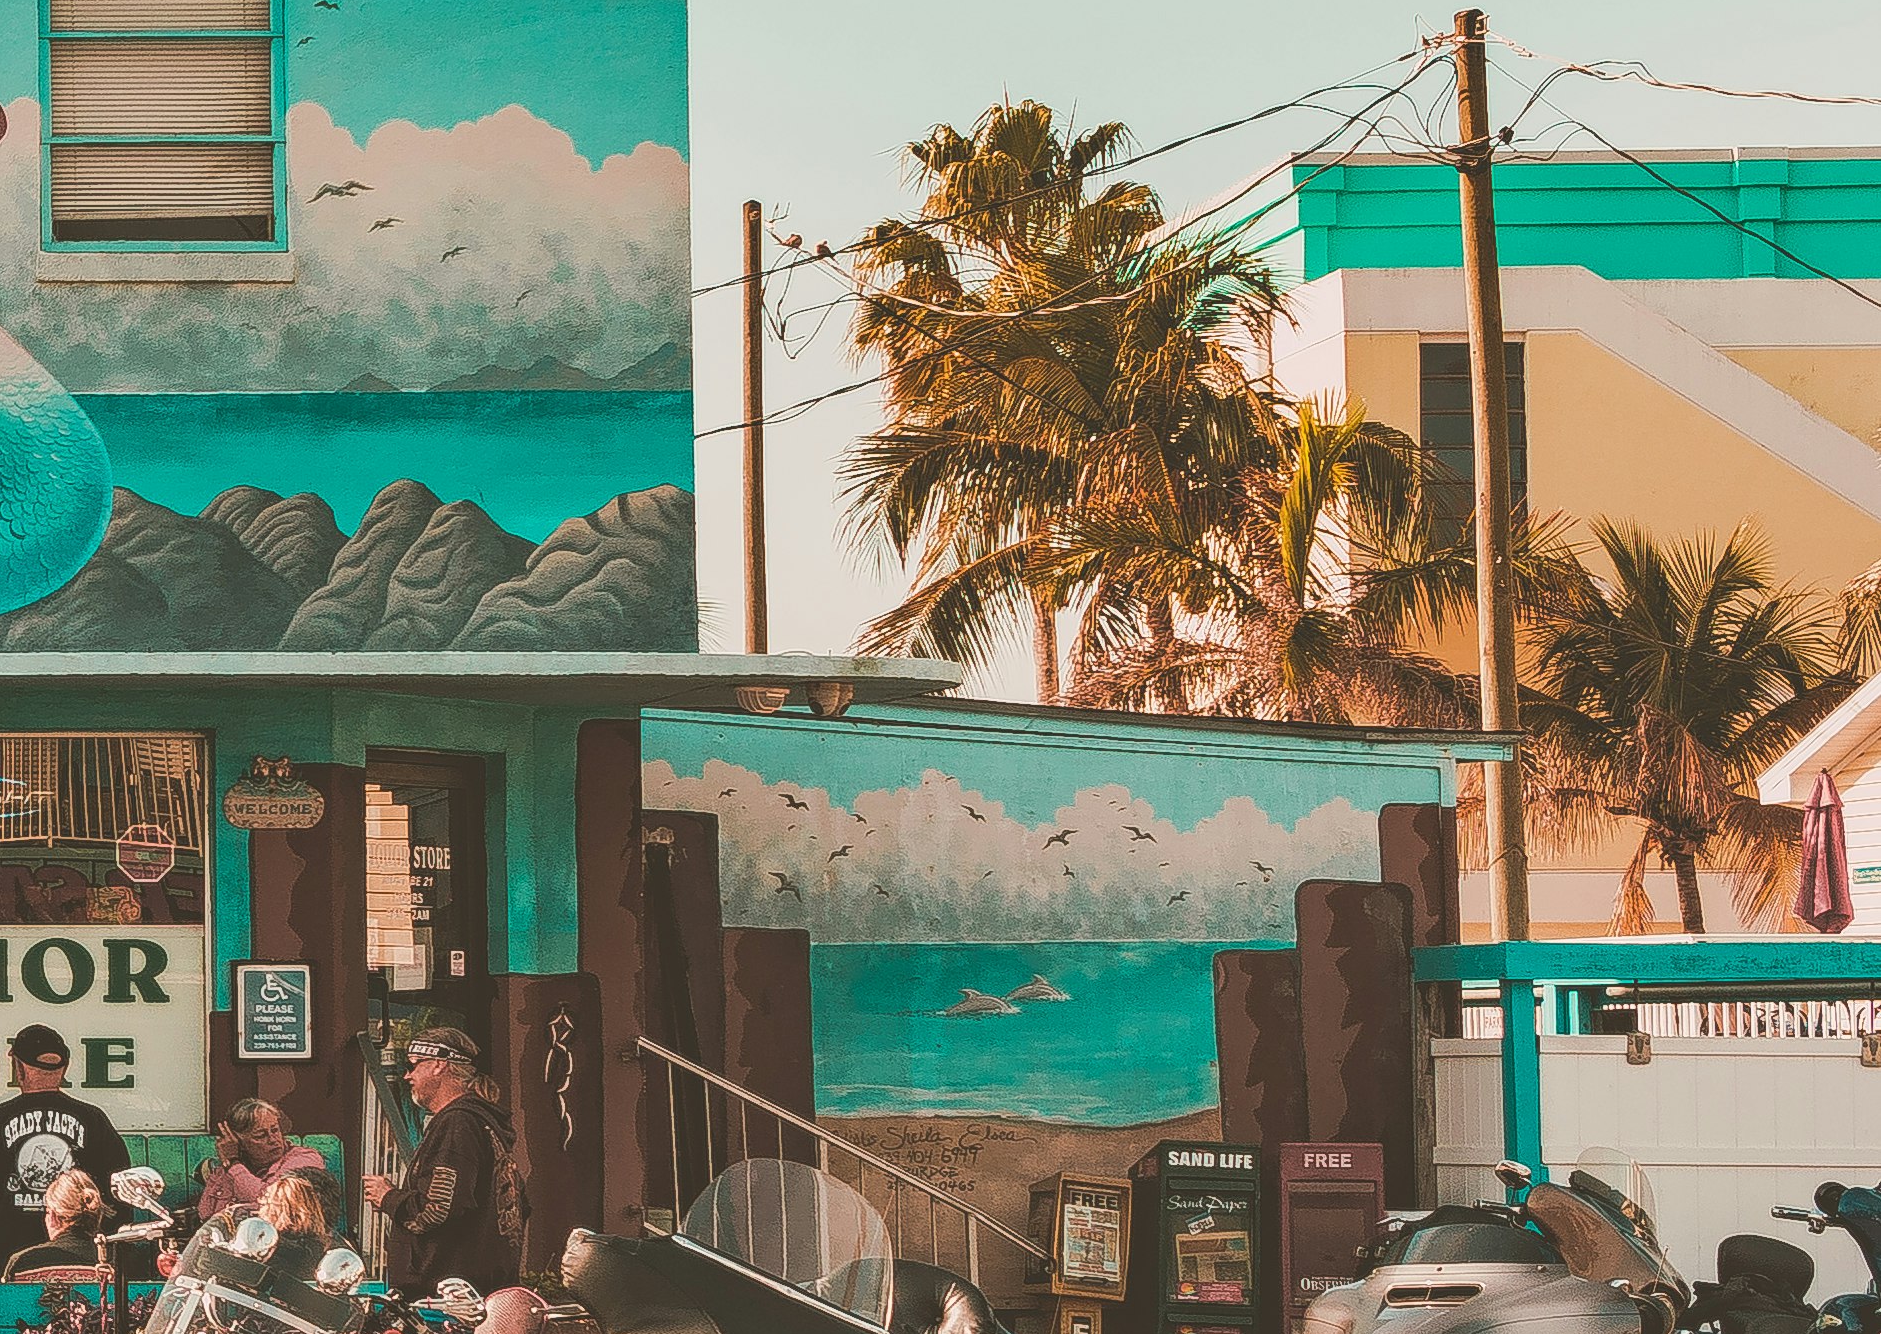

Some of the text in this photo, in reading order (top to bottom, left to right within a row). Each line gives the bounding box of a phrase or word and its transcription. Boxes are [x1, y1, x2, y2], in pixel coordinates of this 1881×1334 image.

[233, 803, 313, 816] WELCOME
[413, 846, 451, 869] STORE
[255, 1004, 295, 1014] PLEASE
[267, 1024, 283, 1032] FOR
[4, 1110, 85, 1149] SHADY JACK'S
[880, 1123, 953, 1150] Sheila
[1167, 1150, 1254, 1170] SAND LIFE
[1303, 1153, 1353, 1168] FREE
[1069, 1190, 1119, 1210] FREE
[1166, 1194, 1209, 1211] Sand
